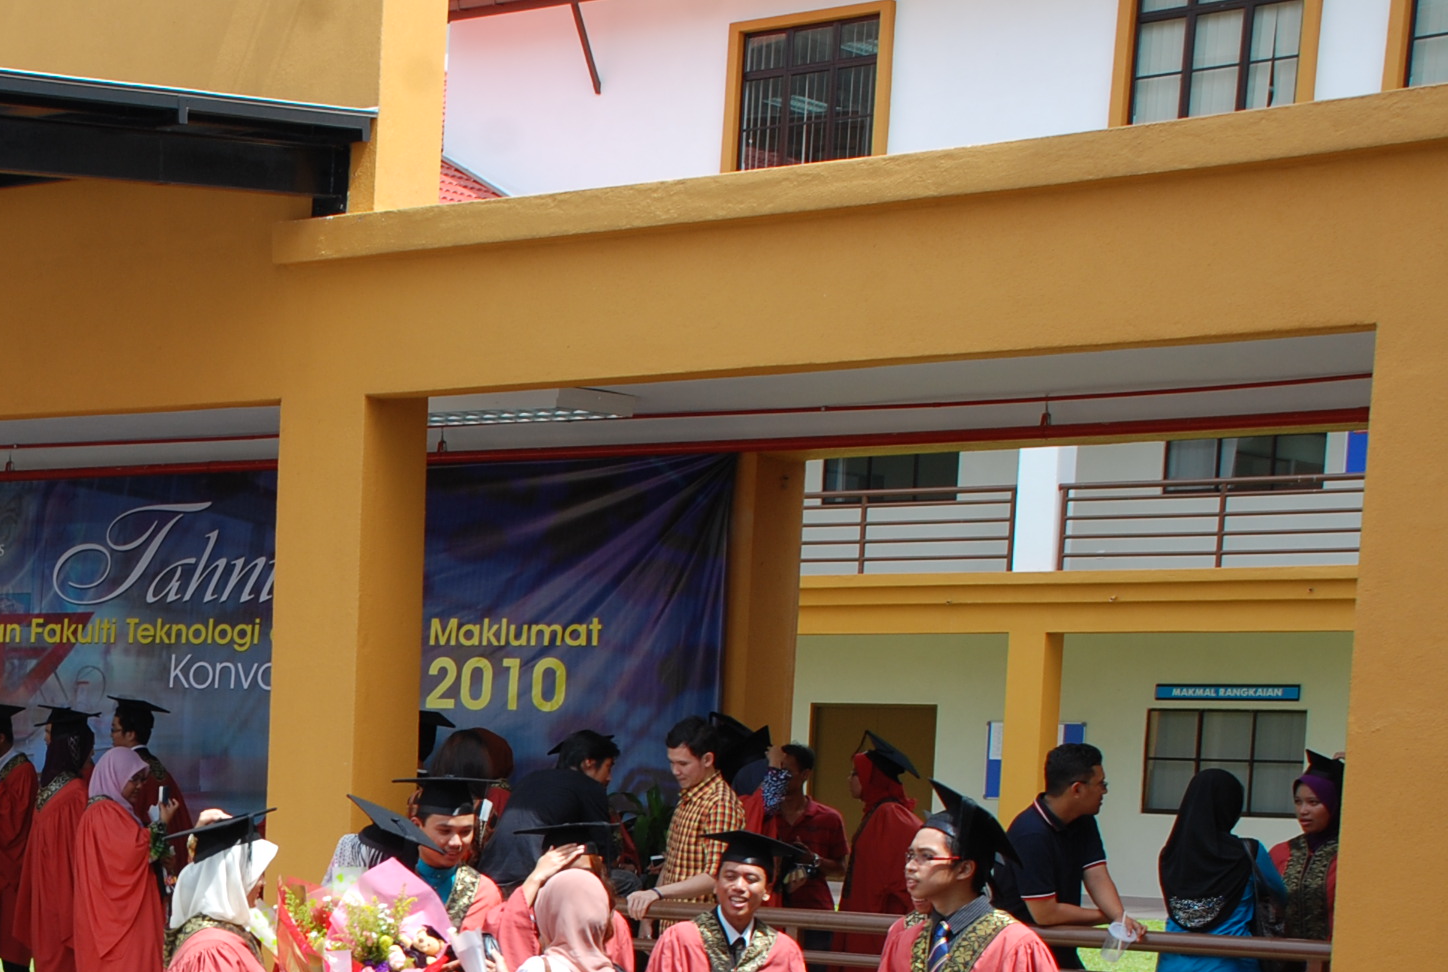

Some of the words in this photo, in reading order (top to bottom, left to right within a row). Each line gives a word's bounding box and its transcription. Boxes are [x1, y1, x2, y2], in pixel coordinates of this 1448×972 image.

[31, 618, 117, 644] Fakulti
[126, 618, 261, 651] Teknologi
[429, 617, 602, 646] Maklumat
[425, 657, 567, 712] 2010
[1172, 688, 1216, 697] MAKMAL
[1219, 688, 1283, 697] RANGKAIAN
